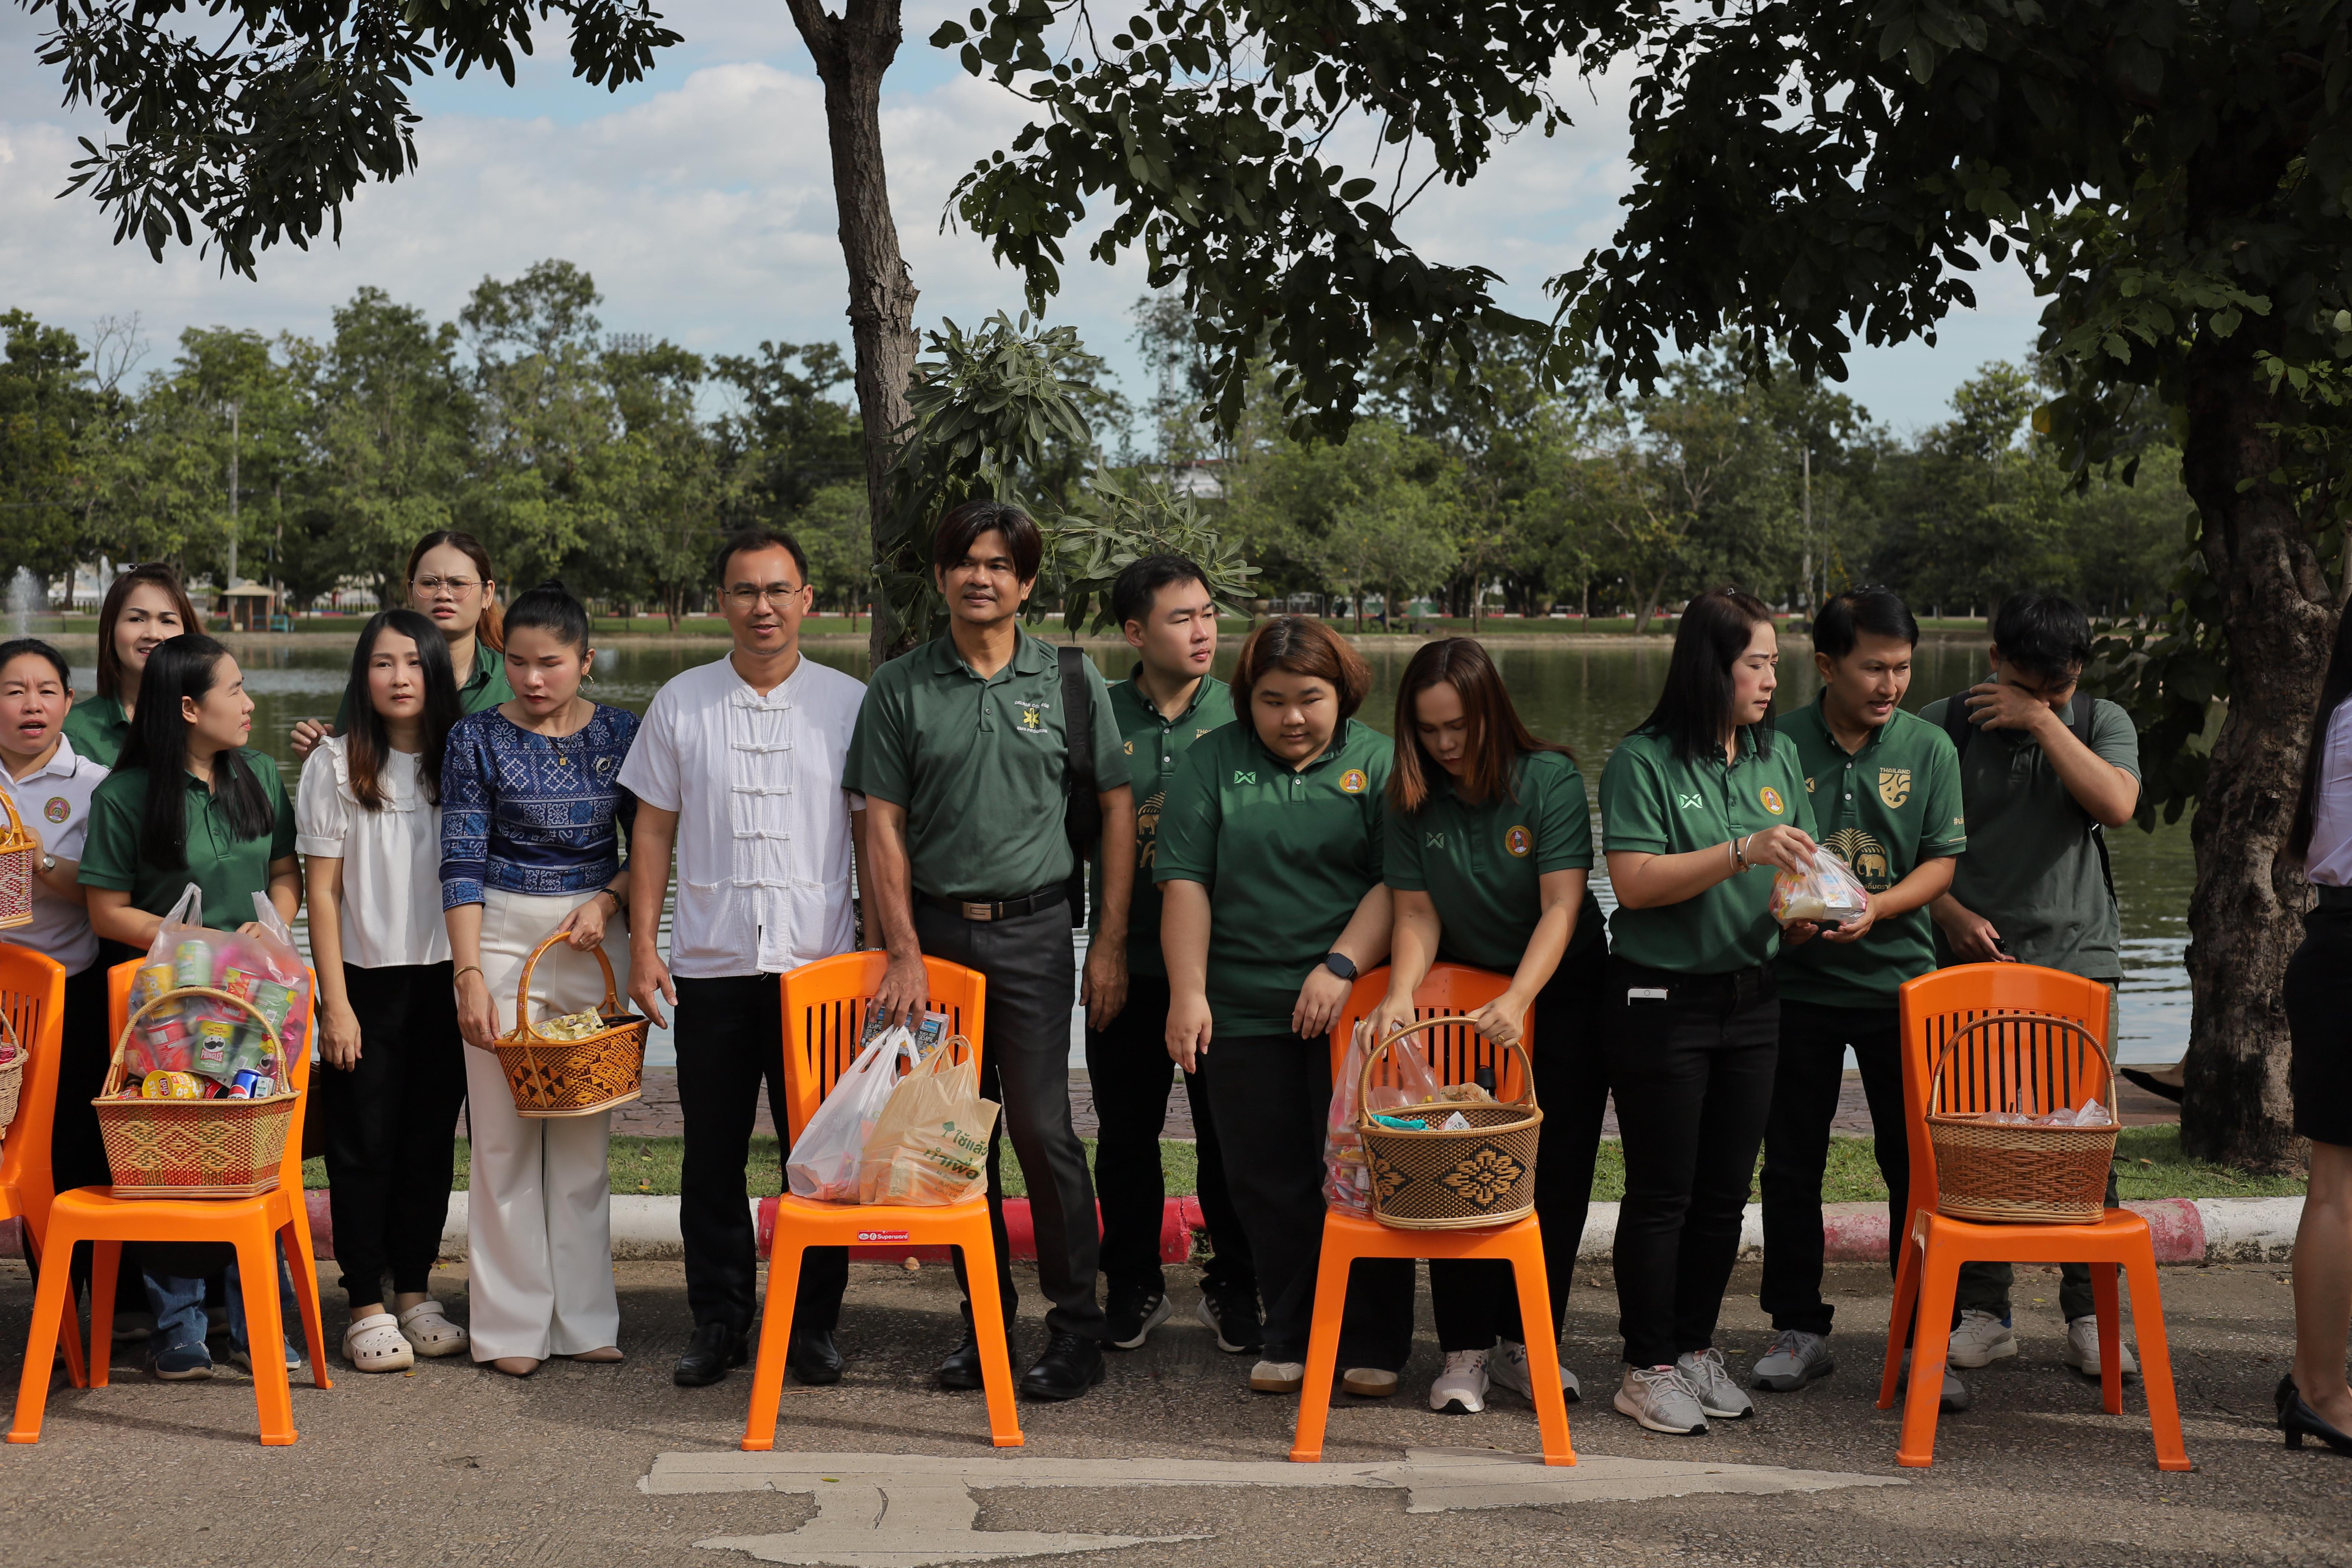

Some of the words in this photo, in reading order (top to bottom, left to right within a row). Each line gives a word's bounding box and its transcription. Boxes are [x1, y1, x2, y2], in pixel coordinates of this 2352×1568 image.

[918, 1034, 934, 1043] SESAME
[201, 1049, 224, 1062] PRINGLES
[159, 1079, 170, 1095] Lay's
